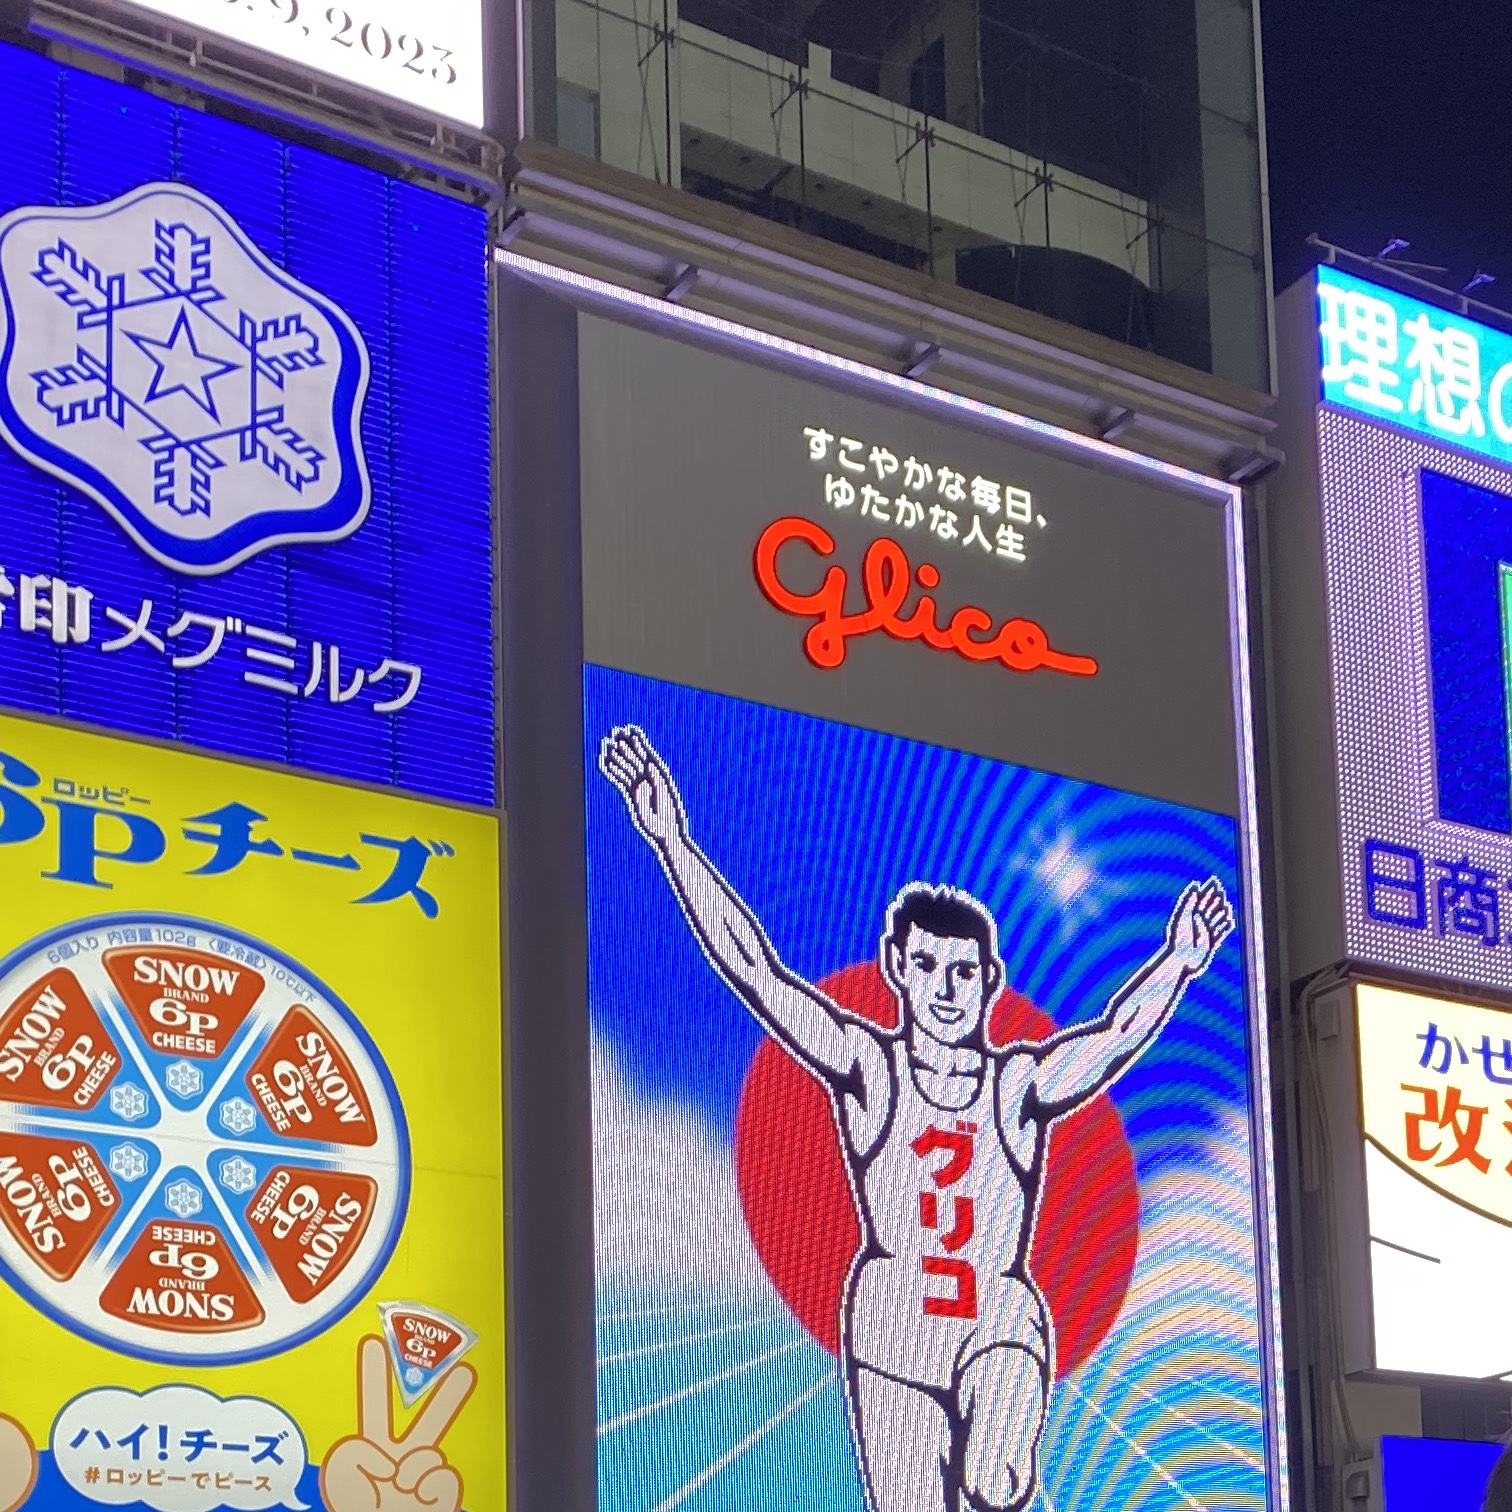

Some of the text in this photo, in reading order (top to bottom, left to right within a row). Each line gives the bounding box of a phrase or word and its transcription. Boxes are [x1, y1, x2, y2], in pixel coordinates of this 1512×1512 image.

[325, 7, 457, 84] 2023
[802, 426, 1048, 529] すこやかな毎日、
[824, 472, 1028, 562] ゆたかな人生
[753, 516, 1098, 676] Glico
[53, 777, 151, 805] ロッピー
[133, 955, 240, 997] SNOW
[162, 987, 209, 1004] BRAND
[0, 985, 68, 1083] SNOW
[34, 1026, 65, 1069] BRAND
[152, 1032, 217, 1055] CHEESE
[73, 1050, 117, 1107] CHEESE
[296, 1030, 368, 1125] SNOW
[299, 1064, 328, 1107] BRAND
[250, 1072, 292, 1132] CHEESE
[33, 1173, 61, 1219] BRAND
[73, 1146, 115, 1209] CHEESE
[250, 1171, 292, 1224] CHEESE
[0, 1154, 66, 1255] SNOW
[908, 1119, 978, 1321] グリコ
[152, 1224, 217, 1246] CHEESE
[296, 1191, 363, 1287] SNOW
[299, 1208, 327, 1247] BRAND
[126, 1287, 236, 1322] SNOW
[158, 1276, 206, 1292] BRAND
[402, 1317, 452, 1344] SNOW
[404, 1353, 434, 1369] CHEESE
[69, 1422, 290, 1466] ハイ!チーズ
[84, 1466, 273, 1492] #ロッピーでピース
